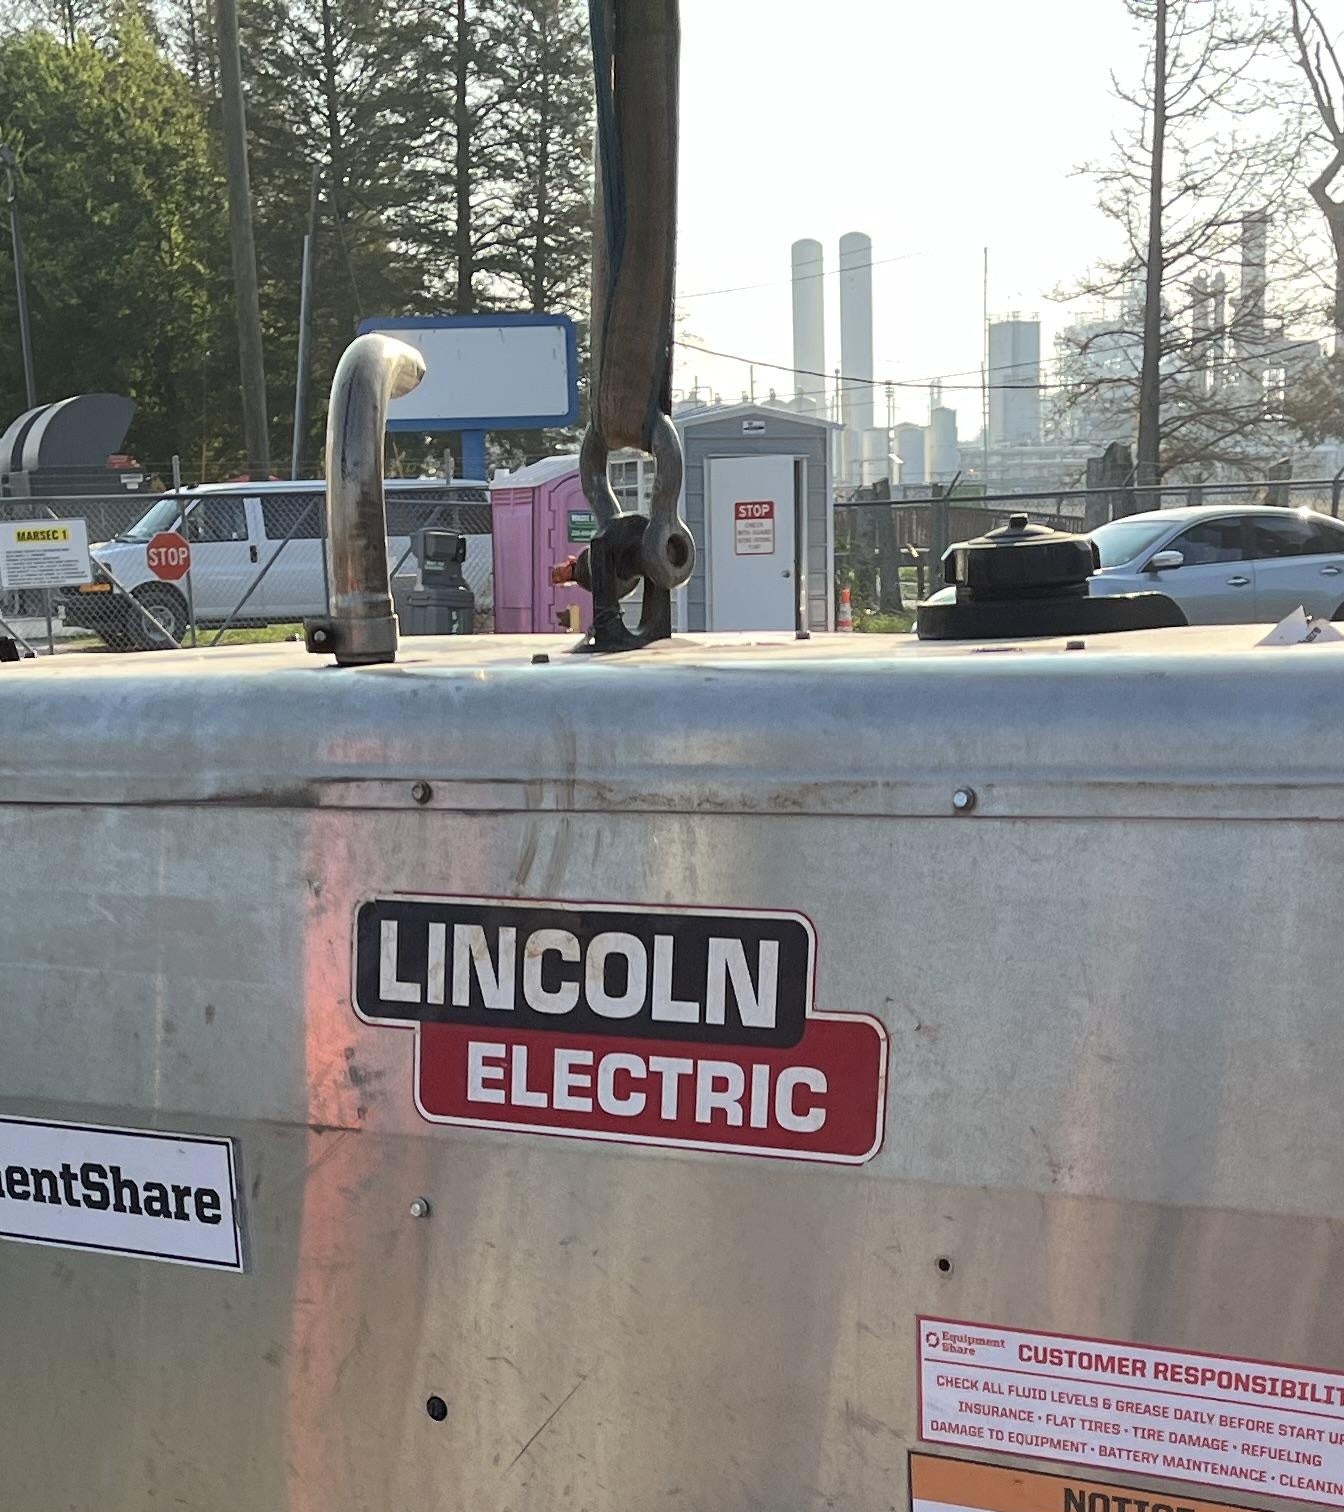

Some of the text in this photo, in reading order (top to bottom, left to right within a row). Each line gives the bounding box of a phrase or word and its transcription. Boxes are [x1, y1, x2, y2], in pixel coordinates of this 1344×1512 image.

[738, 503, 770, 518] STOP
[16, 530, 68, 542] MARSEC 1
[147, 548, 189, 566] STOP
[378, 918, 781, 1029] LINCOLN
[466, 1039, 828, 1134] ELECTRIC
[942, 1331, 1006, 1348] Equipment
[942, 1342, 976, 1356] Share
[1018, 1343, 1147, 1379] CUSTOMER
[936, 1374, 979, 1391] CHECK
[982, 1380, 1005, 1396] ALL
[1008, 1384, 1047, 1401] FLUID
[1050, 1390, 1099, 1408] LEVELS
[1115, 1399, 1169, 1418] GREASE
[1174, 1407, 1215, 1426] DAILY
[1219, 1414, 1274, 1435] BEFORE
[1278, 1424, 1325, 1443] START
[930, 1419, 984, 1439] DAMAGE
[988, 1427, 1004, 1442] TO
[1008, 1431, 1088, 1453] EQUIPMENT
[1098, 1444, 1160, 1465] BATTERY
[1162, 1454, 1267, 1483] MAINTENANCE
[958, 1400, 1323, 1468] INSURANCE FLAT TIRES TIRE DAMAGE REFUELING
